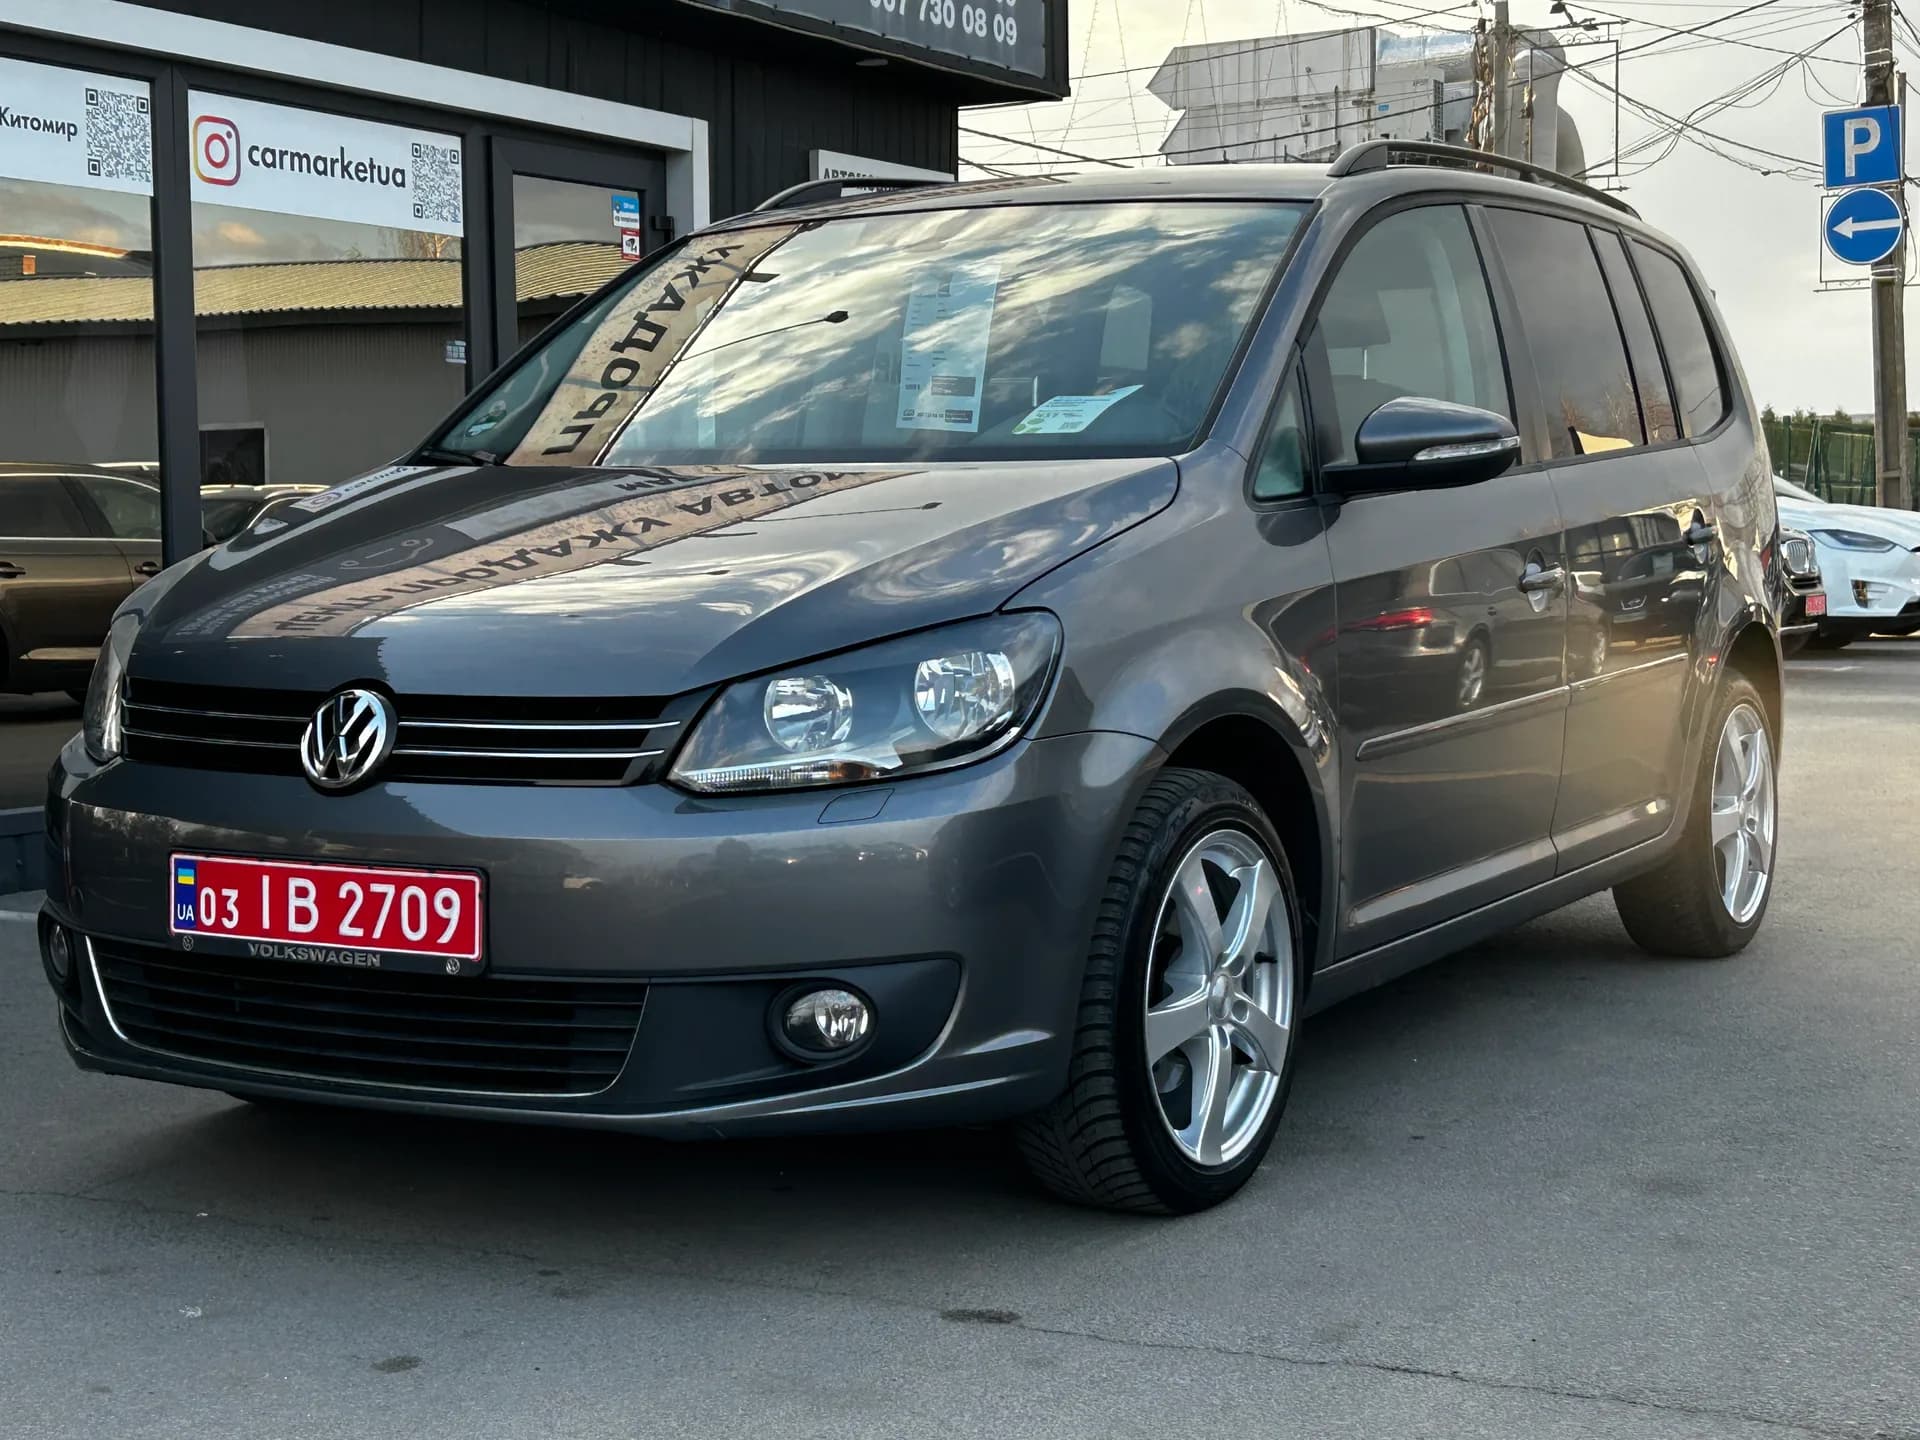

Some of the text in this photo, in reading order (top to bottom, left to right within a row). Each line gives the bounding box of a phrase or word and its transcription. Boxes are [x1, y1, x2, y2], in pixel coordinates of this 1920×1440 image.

[962, 4, 987, 38] 08
[993, 13, 1017, 46] 09
[248, 144, 406, 188] carmarketua
[1844, 117, 1881, 178] P
[177, 874, 461, 944] UA 03 IB 2709
[248, 942, 381, 968] VOLKSWAGEN
